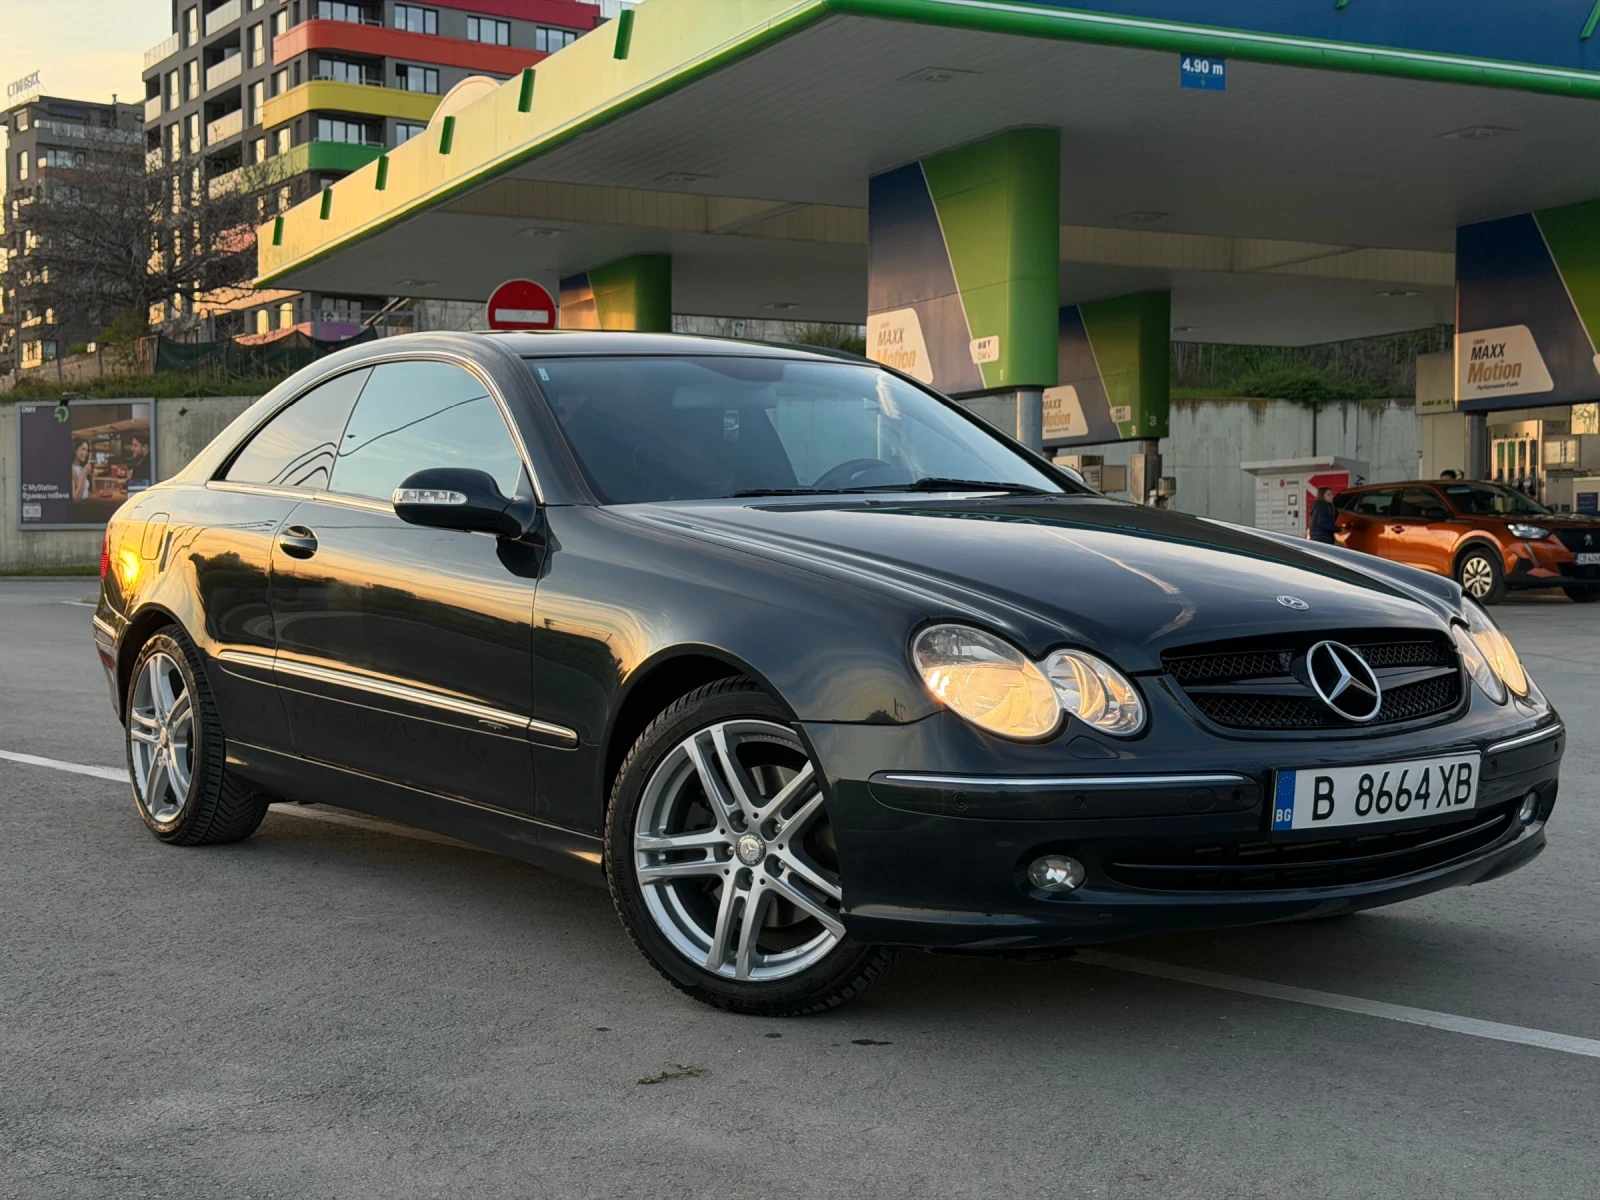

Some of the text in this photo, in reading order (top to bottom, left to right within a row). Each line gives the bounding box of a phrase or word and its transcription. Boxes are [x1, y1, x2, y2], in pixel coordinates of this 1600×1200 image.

[1182, 58, 1223, 76] 4.90 m
[877, 327, 905, 348] MAXX
[876, 345, 917, 370] Motion
[1471, 343, 1506, 360] MAXX
[1467, 359, 1522, 384] Motion
[1506, 381, 1519, 389] Fuels
[1131, 425, 1137, 437] 3
[29, 483, 59, 493] MyStation
[1312, 762, 1472, 821] B 8664 XB
[1275, 808, 1292, 823] BG
